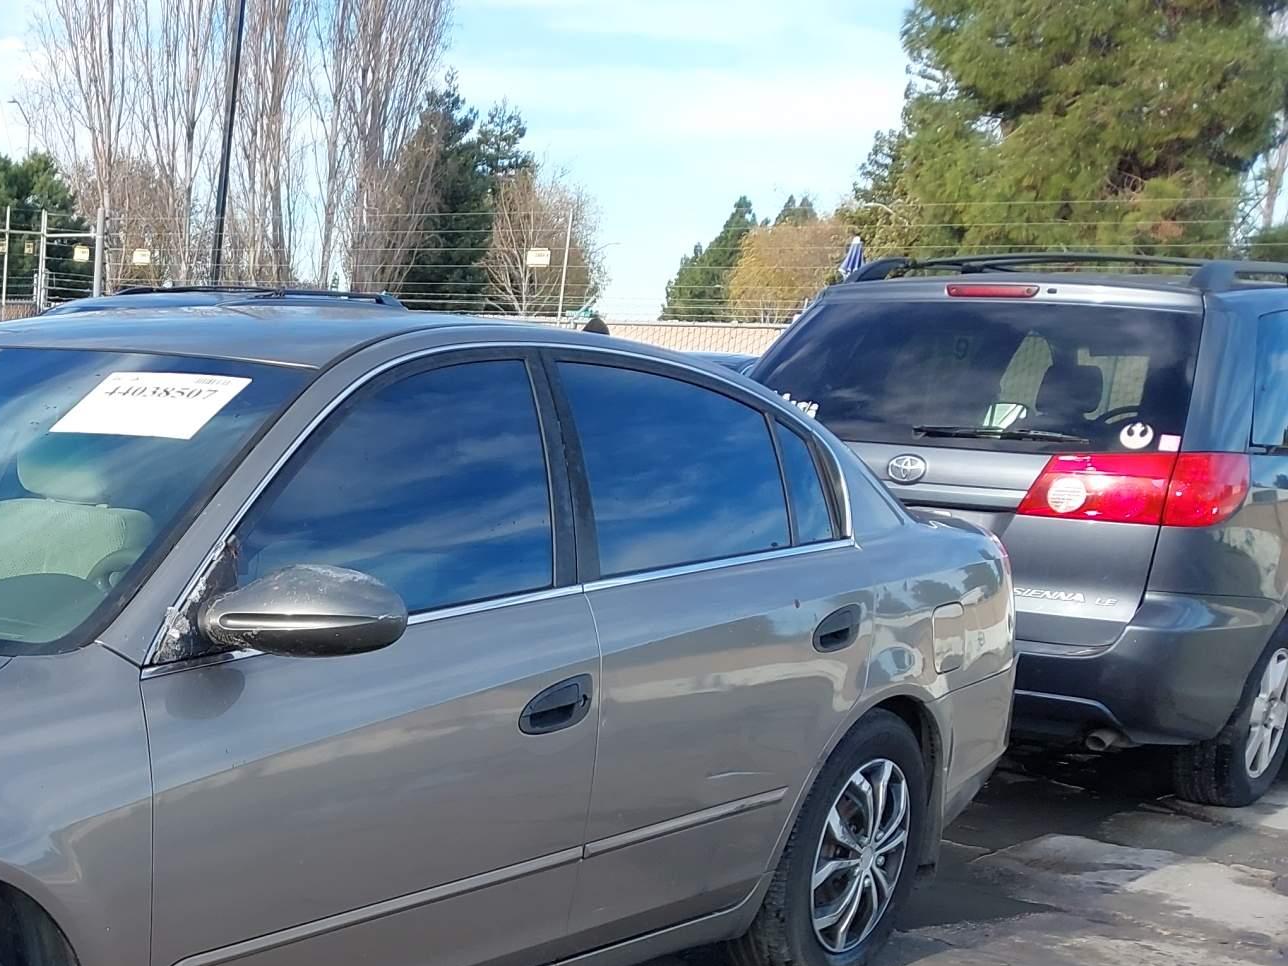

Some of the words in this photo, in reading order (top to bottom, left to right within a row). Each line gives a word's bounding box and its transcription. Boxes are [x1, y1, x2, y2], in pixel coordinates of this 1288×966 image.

[105, 385, 219, 400] 44038507
[1013, 586, 1086, 604] SIENNA
[1094, 597, 1119, 607] LE
